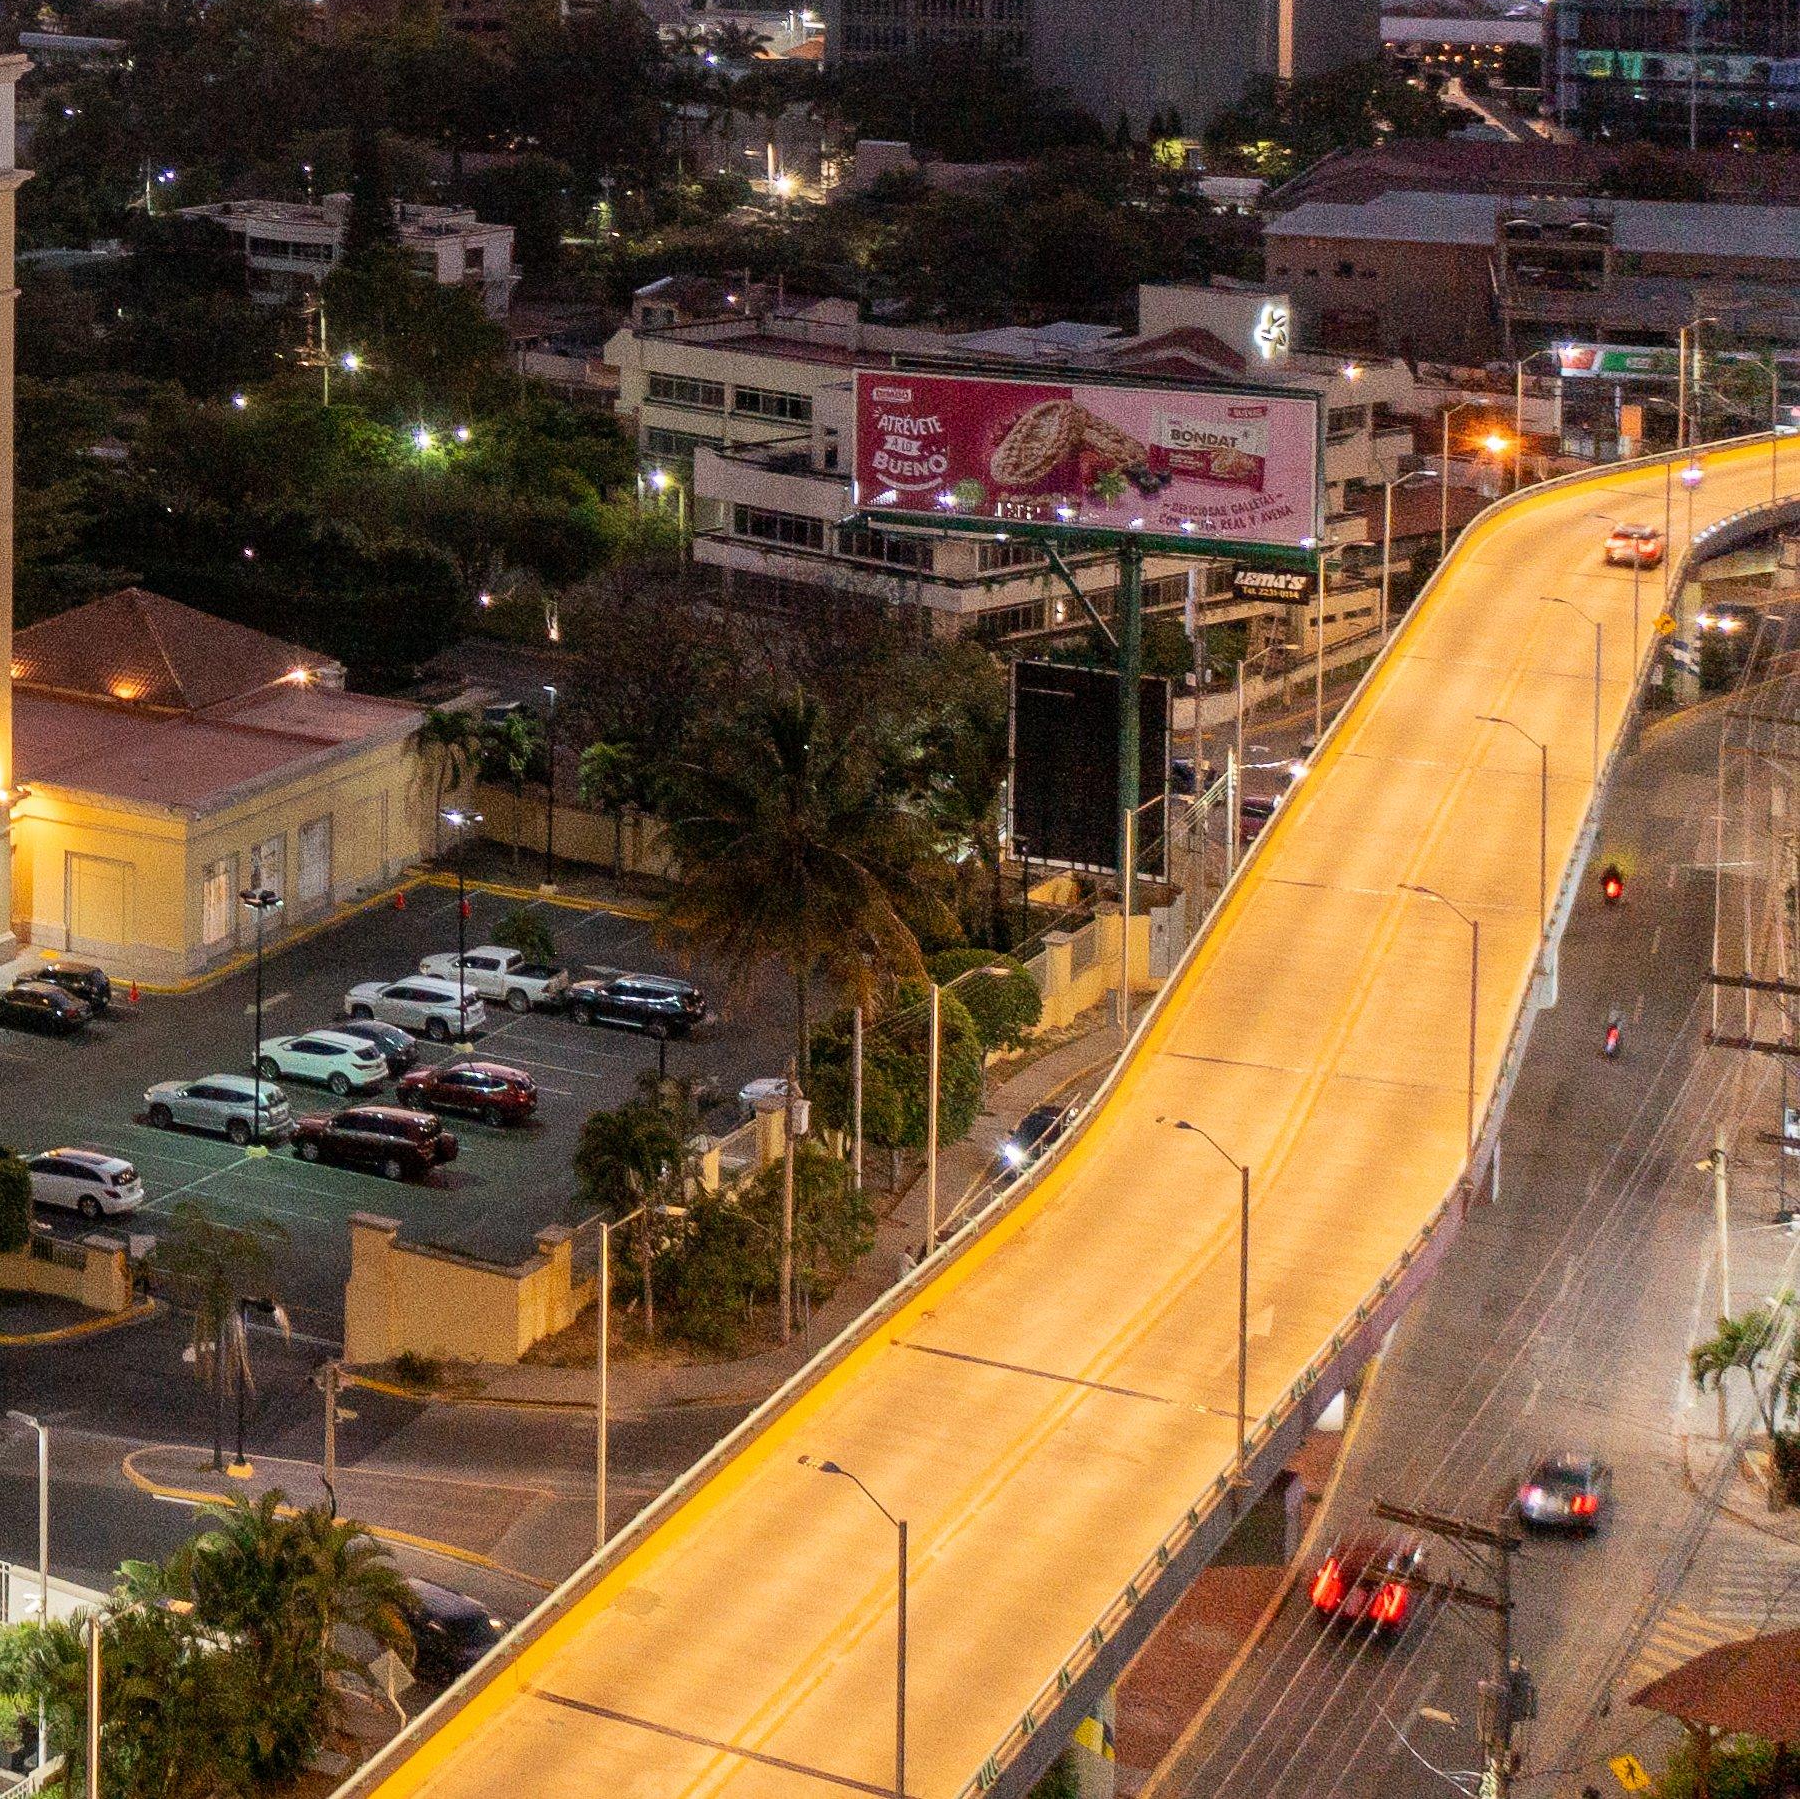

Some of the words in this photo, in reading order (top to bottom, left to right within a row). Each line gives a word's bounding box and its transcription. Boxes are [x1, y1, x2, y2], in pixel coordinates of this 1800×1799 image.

[878, 414, 943, 436] ATRÉVETE
[1170, 429, 1239, 447] BONDAT
[872, 451, 948, 476] BUENO
